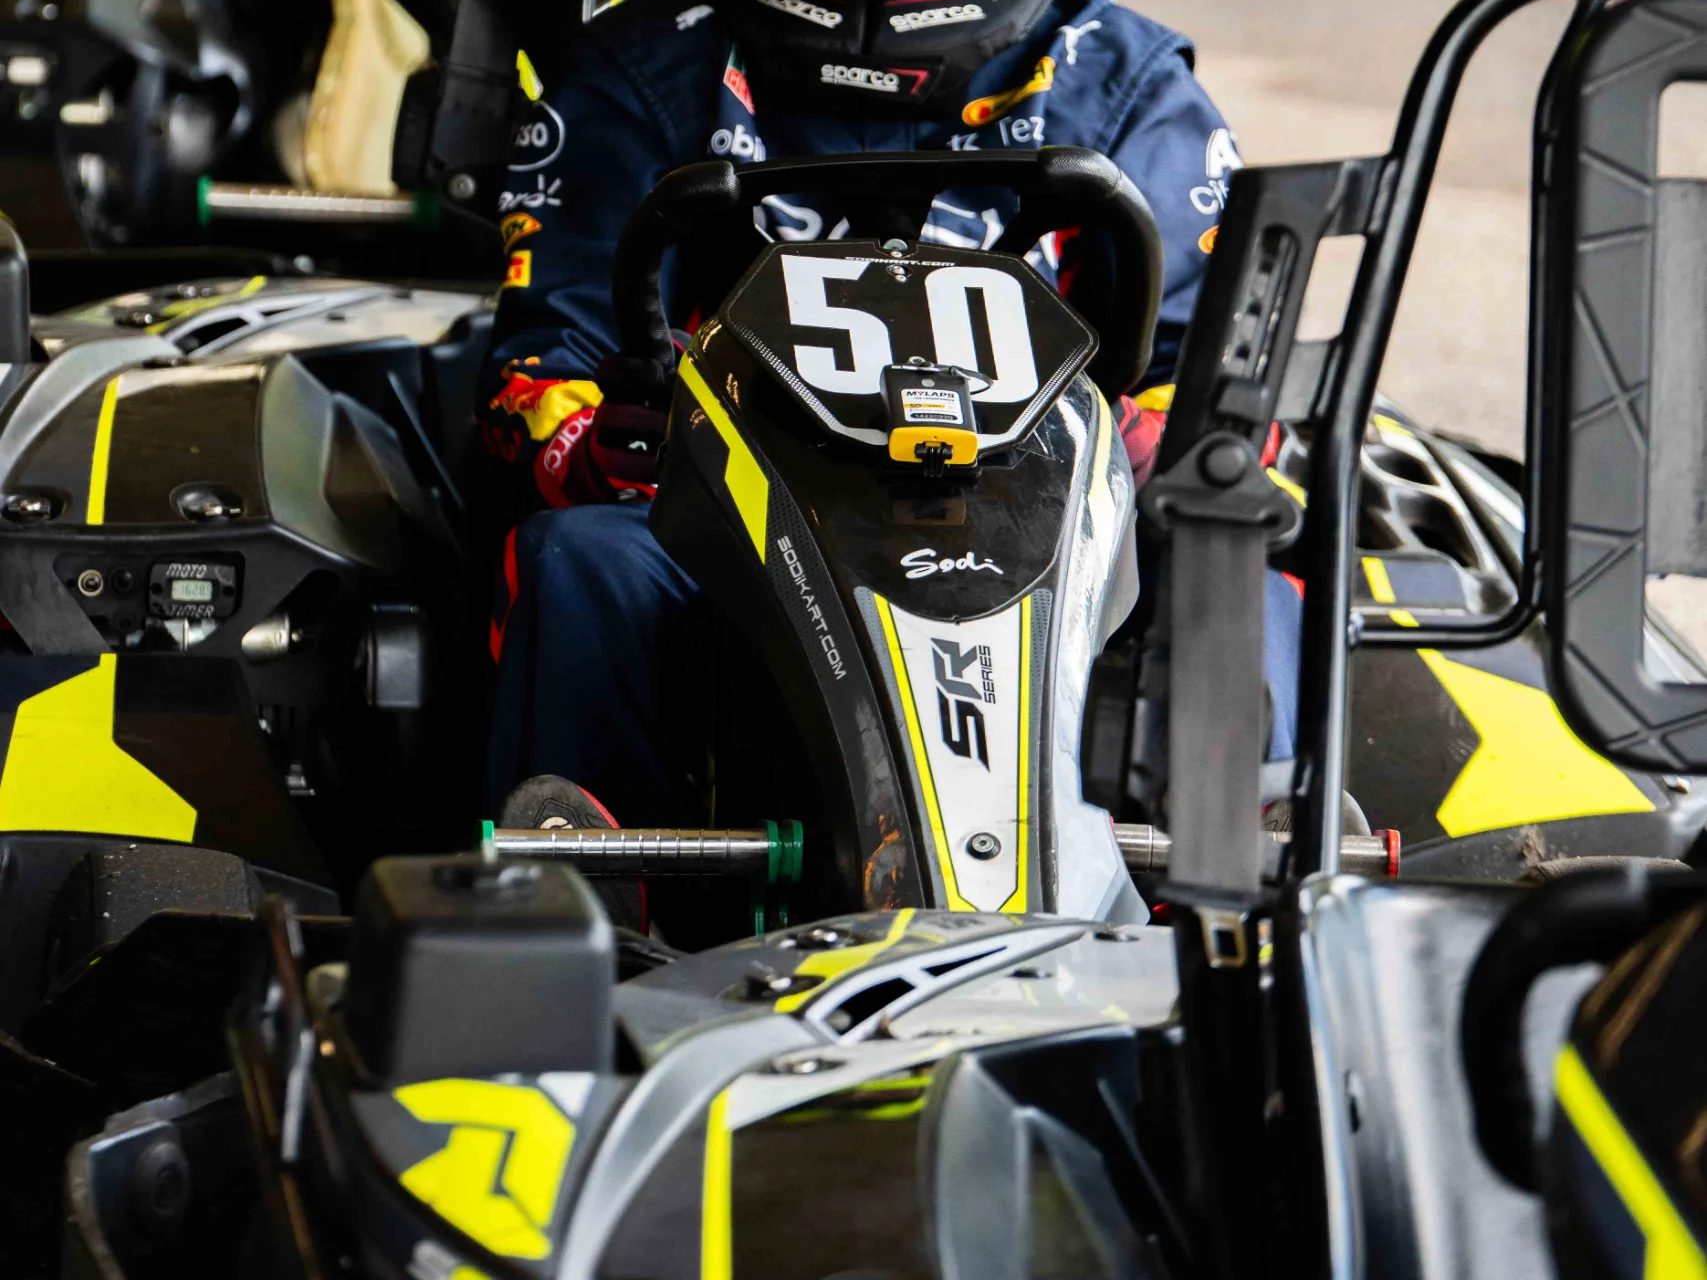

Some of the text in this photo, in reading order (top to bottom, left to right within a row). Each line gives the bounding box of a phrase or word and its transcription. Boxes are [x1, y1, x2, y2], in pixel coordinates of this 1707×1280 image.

[889, 4, 985, 32] sparco
[820, 64, 900, 91] sparco
[781, 254, 1039, 403] 50
[906, 391, 955, 399] MYLAPS
[166, 563, 207, 579] MOTO
[900, 548, 1003, 580] Sodi
[170, 604, 215, 619] TIMER
[978, 644, 996, 705] SERIES
[931, 637, 990, 773] SR
